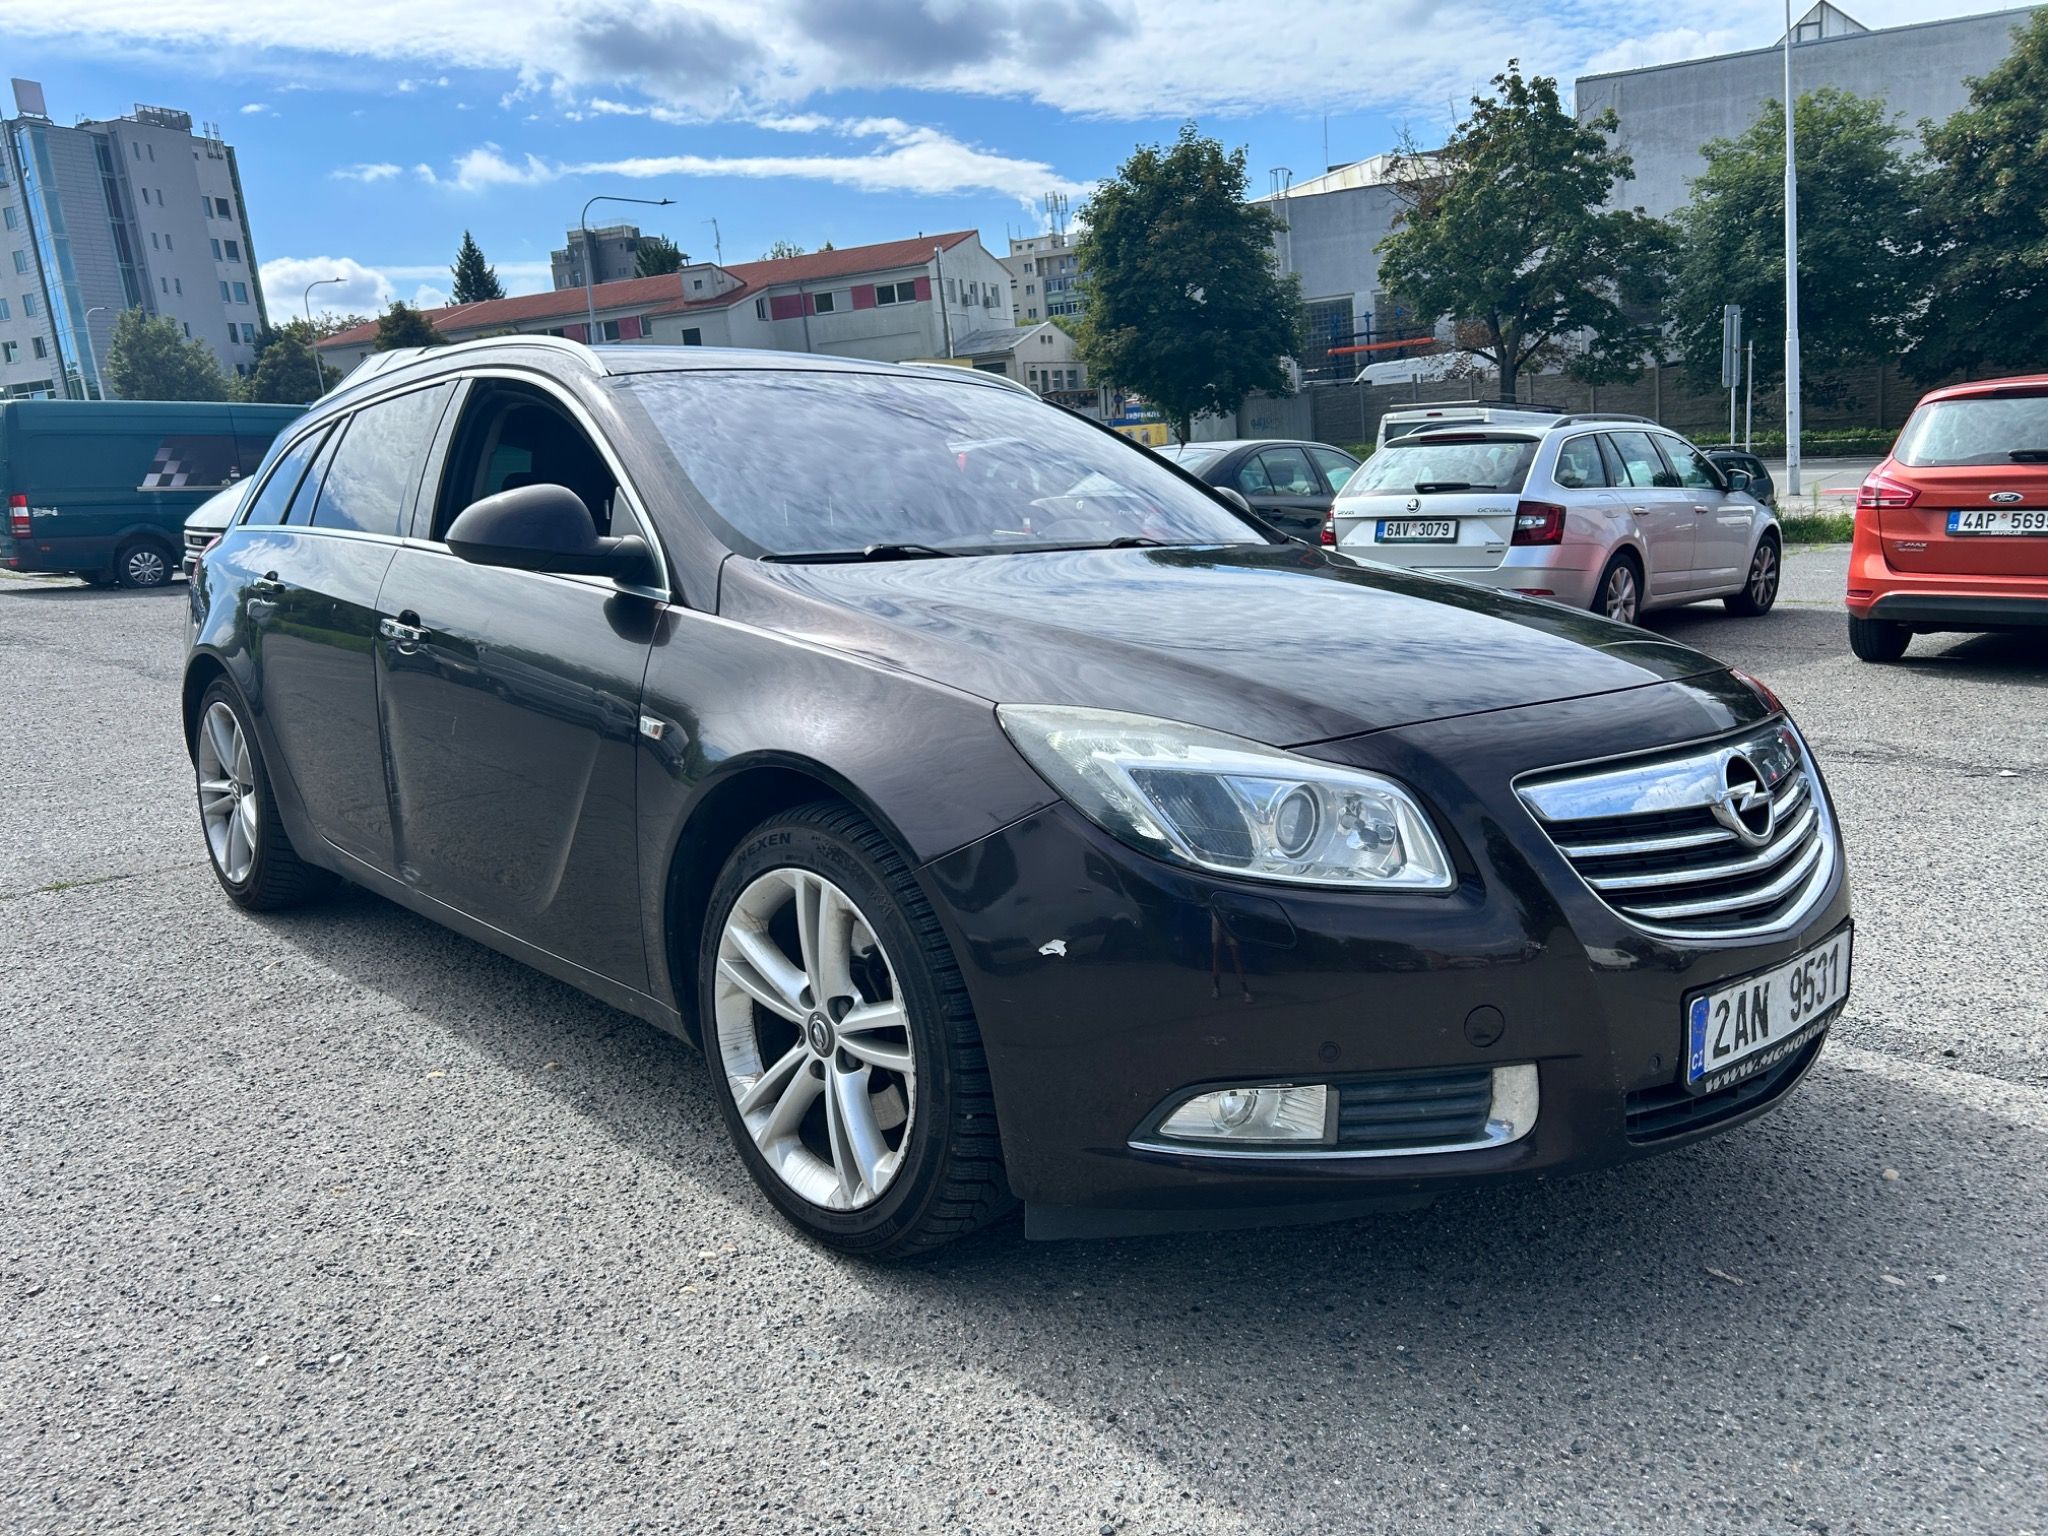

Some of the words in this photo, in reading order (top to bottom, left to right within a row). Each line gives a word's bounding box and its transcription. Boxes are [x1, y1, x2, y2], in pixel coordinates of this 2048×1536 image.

[1386, 523, 1409, 536] 6AV
[1418, 523, 1449, 536] 3079
[1963, 513, 1997, 529] 4AP
[2010, 513, 2048, 529] 569
[737, 832, 791, 866] NEXEN
[1712, 982, 1770, 1060] 2AN
[1789, 943, 1839, 1022] 9531
[1691, 1052, 1704, 1071] CZ
